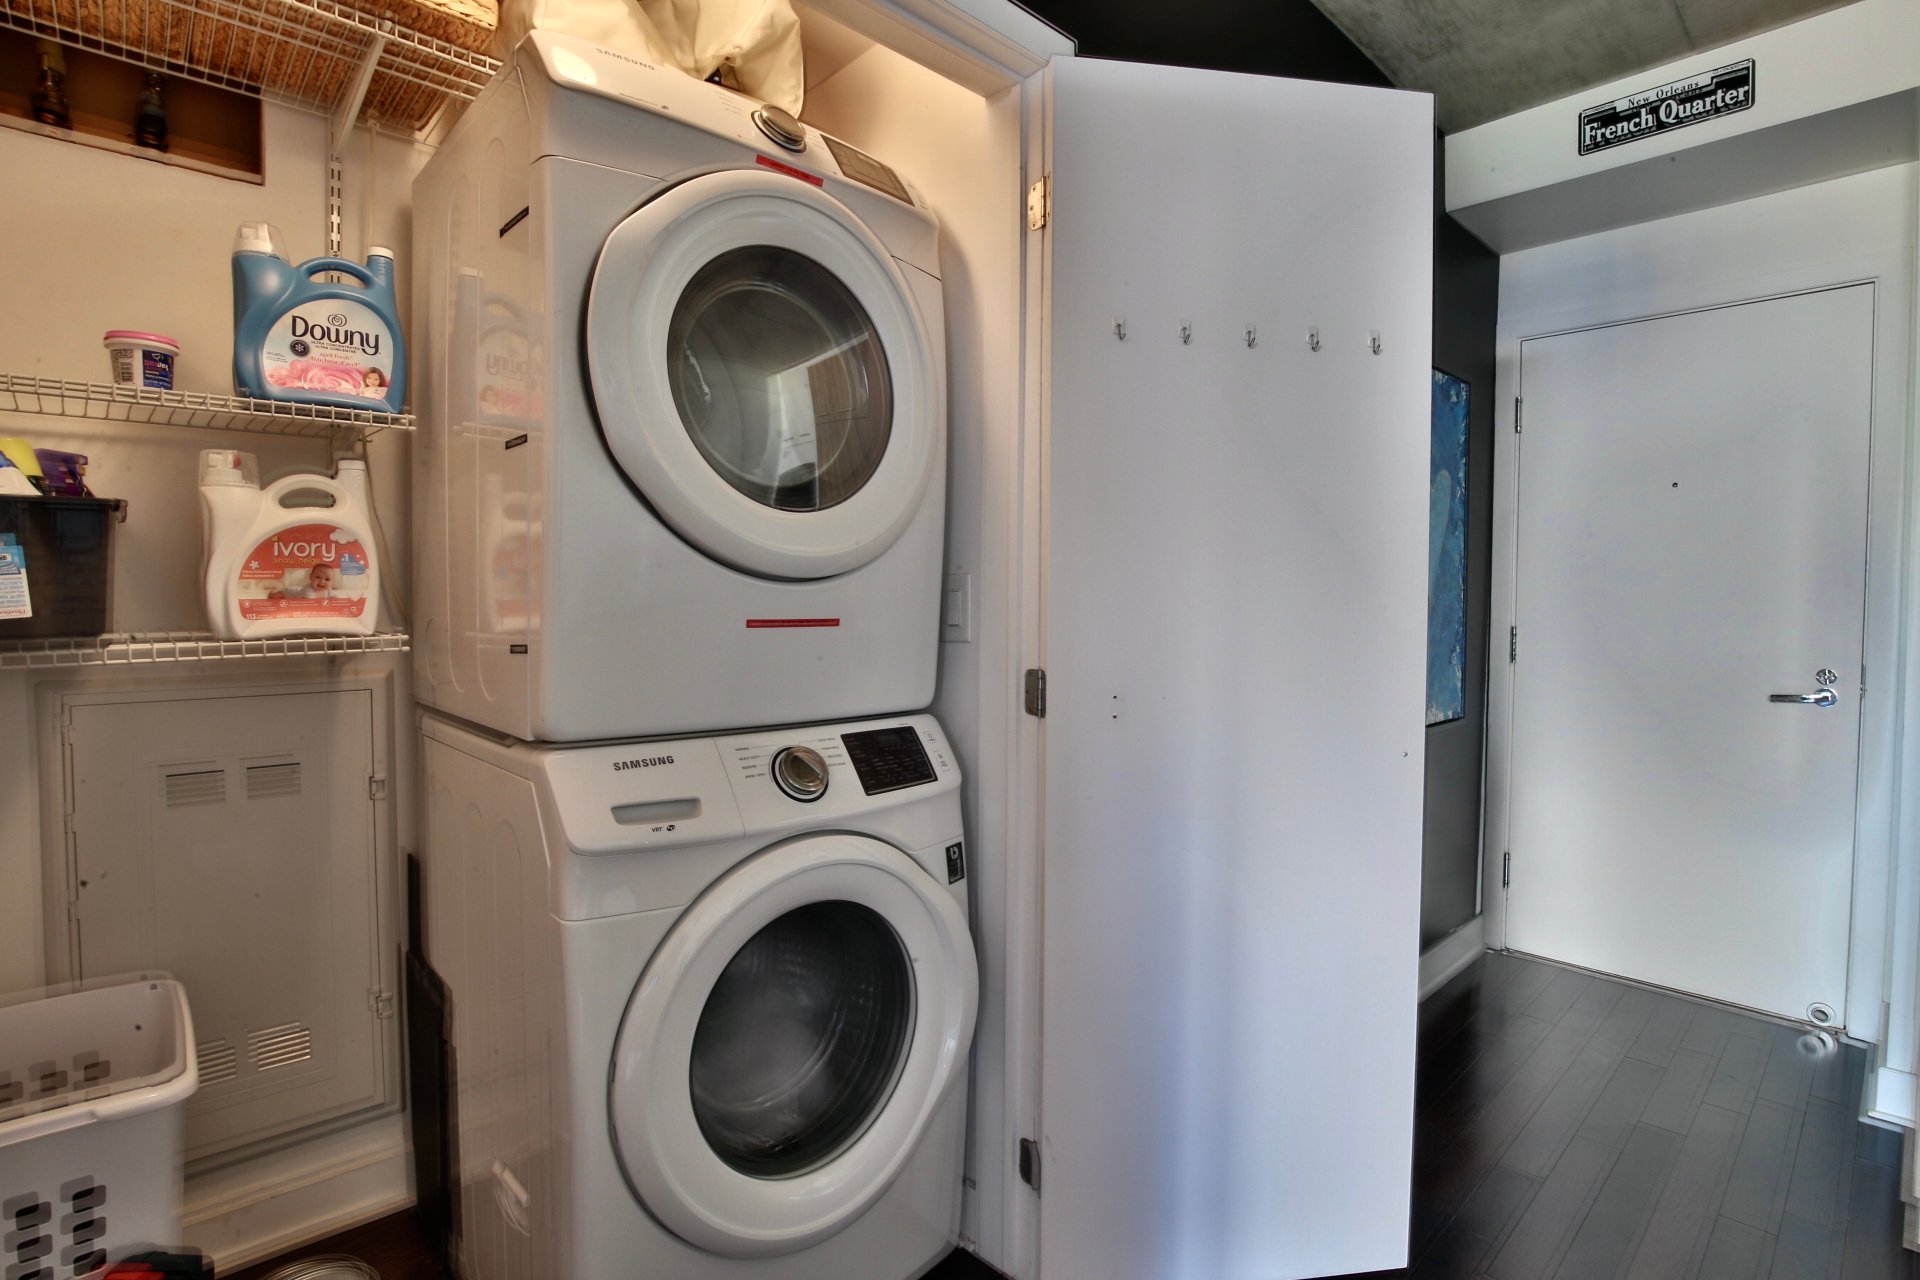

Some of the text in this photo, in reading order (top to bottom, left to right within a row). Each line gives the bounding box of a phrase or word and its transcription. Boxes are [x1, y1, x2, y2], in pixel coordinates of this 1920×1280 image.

[596, 47, 655, 71] SAMSUNG
[1628, 95, 1651, 108] New
[1656, 80, 1700, 100] Orleans
[1583, 85, 1749, 146] French Quarter
[291, 314, 380, 356] Downy
[272, 535, 337, 562] ivory
[612, 755, 675, 772] SAMSUNG
